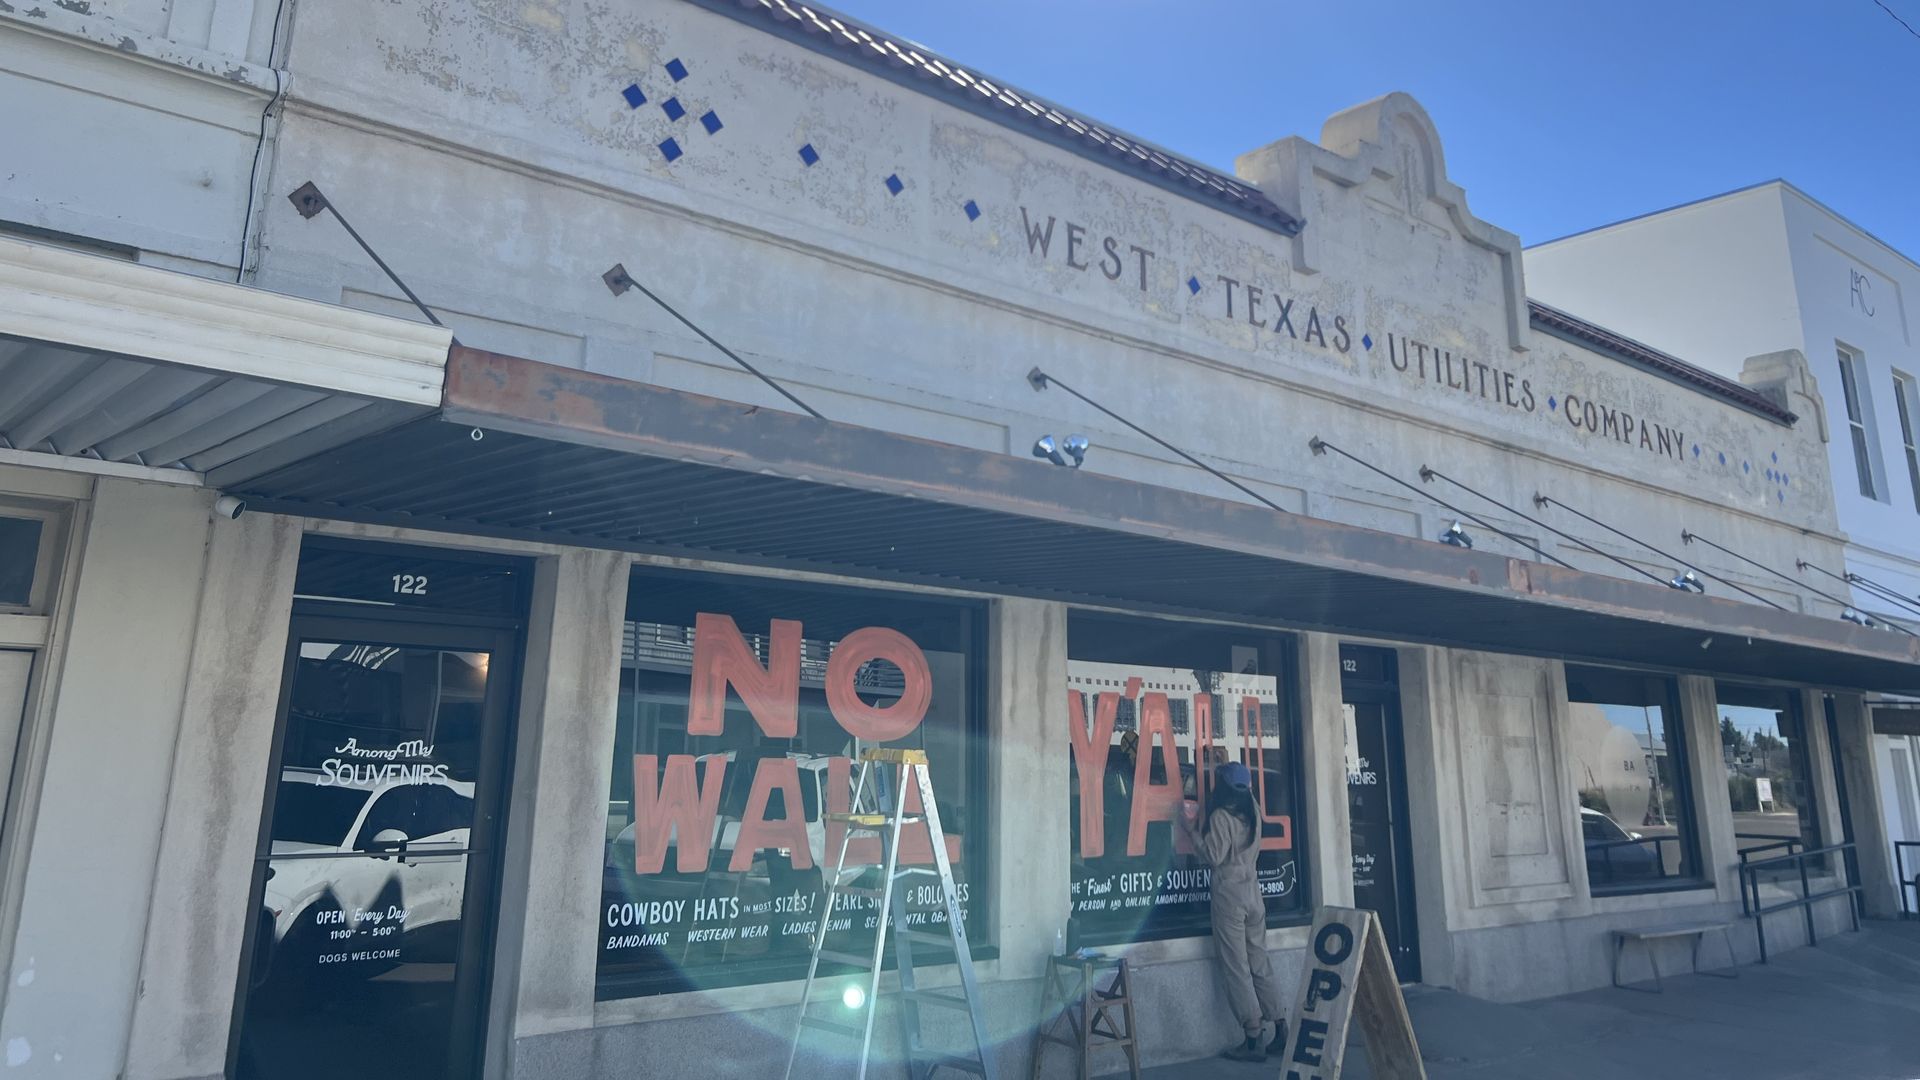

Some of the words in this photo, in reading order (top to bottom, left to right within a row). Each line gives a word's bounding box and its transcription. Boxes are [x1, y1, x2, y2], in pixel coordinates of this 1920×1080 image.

[1019, 206, 1155, 292] WEST
[1217, 274, 1351, 353] TEXAS
[1387, 332, 1535, 412] UTILITIES
[1564, 394, 1684, 461] COMPANY
[392, 574, 428, 595] 122
[688, 612, 933, 742] NO
[1343, 659, 1357, 672] 122
[335, 737, 398, 761] Among
[396, 739, 434, 758] My
[315, 758, 449, 787] SOUVENIRS
[633, 753, 960, 875] WALL
[1071, 882, 1080, 894] HE
[1120, 872, 1153, 893] GIFTS
[1157, 875, 1163, 888] &
[1166, 869, 1211, 890] SOUVEN
[607, 900, 686, 928] COWBOY
[693, 897, 739, 921] HATS
[743, 905, 751, 913] IN
[752, 901, 771, 913] MOST
[774, 892, 816, 914] SIZES!
[835, 892, 863, 911] EARL
[906, 889, 914, 903] &
[1078, 899, 1106, 911] PERSON
[1110, 899, 1122, 911] AND
[1125, 896, 1151, 908] ONLINE
[316, 910, 346, 925] OPEN
[606, 932, 669, 950] BANDANAS
[687, 927, 736, 943] WESTERN
[741, 925, 769, 939] WEAR
[782, 920, 817, 935] LADIES
[826, 918, 852, 931] ENIM
[319, 952, 348, 964] DOGS
[351, 948, 401, 961] WELCOME
[1286, 922, 1354, 1080] OPE
